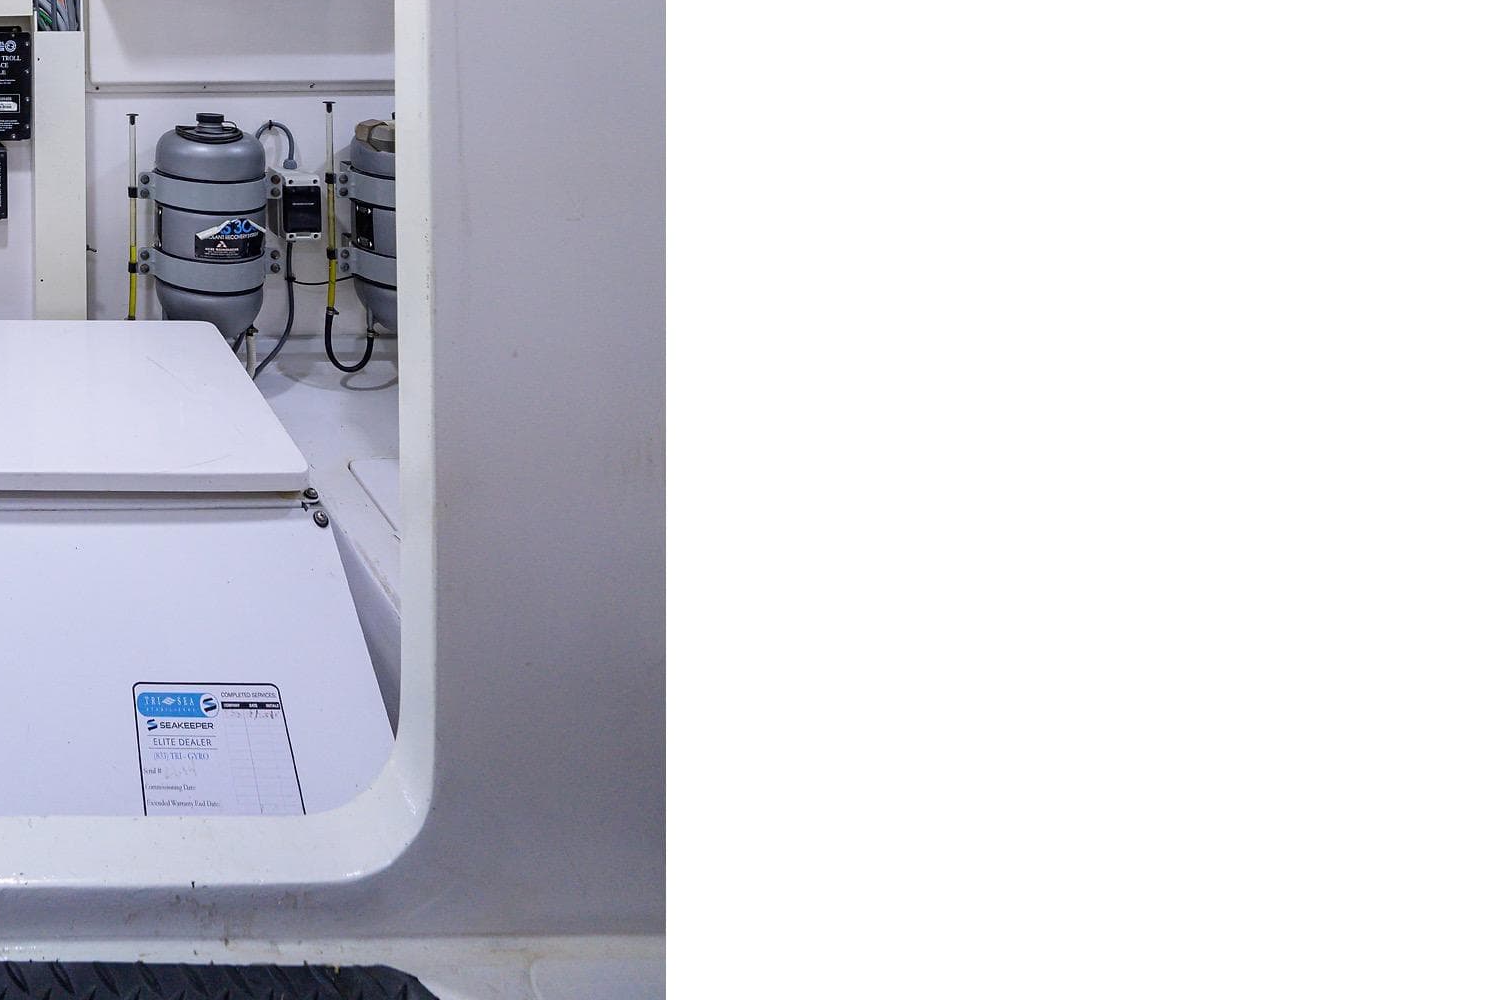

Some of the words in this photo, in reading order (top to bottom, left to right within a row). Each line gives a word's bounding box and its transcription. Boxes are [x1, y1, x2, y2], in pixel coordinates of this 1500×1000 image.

[144, 696, 161, 706] TRI
[177, 697, 195, 706] SEA
[159, 721, 214, 730] SEAKEEPER
[153, 738, 176, 746] ELITE
[179, 738, 212, 747] DEALER
[170, 752, 182, 760] TRI
[187, 752, 209, 760] GYRO
[170, 799, 194, 809] Warranty
